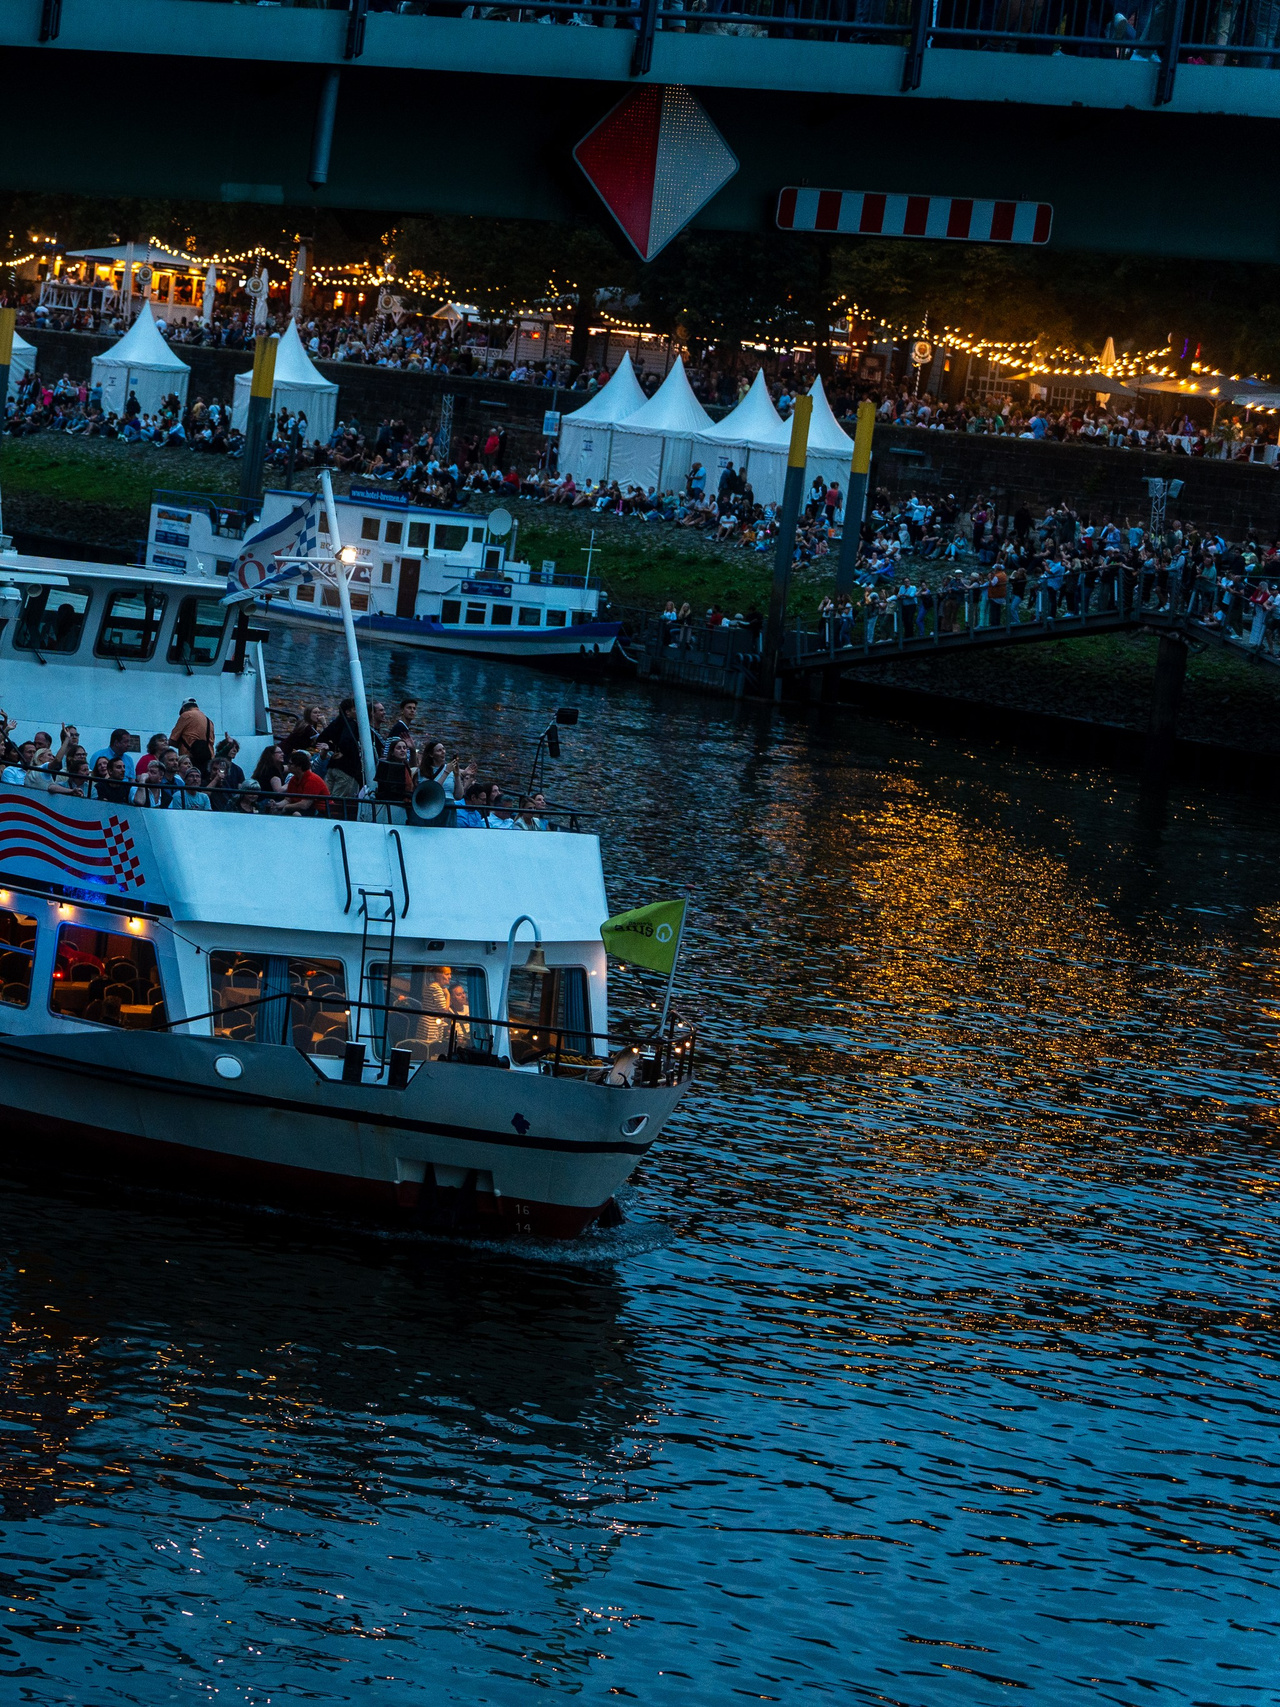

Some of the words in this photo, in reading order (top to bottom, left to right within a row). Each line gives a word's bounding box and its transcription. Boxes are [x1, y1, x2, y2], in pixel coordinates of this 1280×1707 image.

[351, 490, 407, 504] www.hotel-bremen.de
[515, 1203, 530, 1215] 16
[515, 1222, 531, 1234] 14
